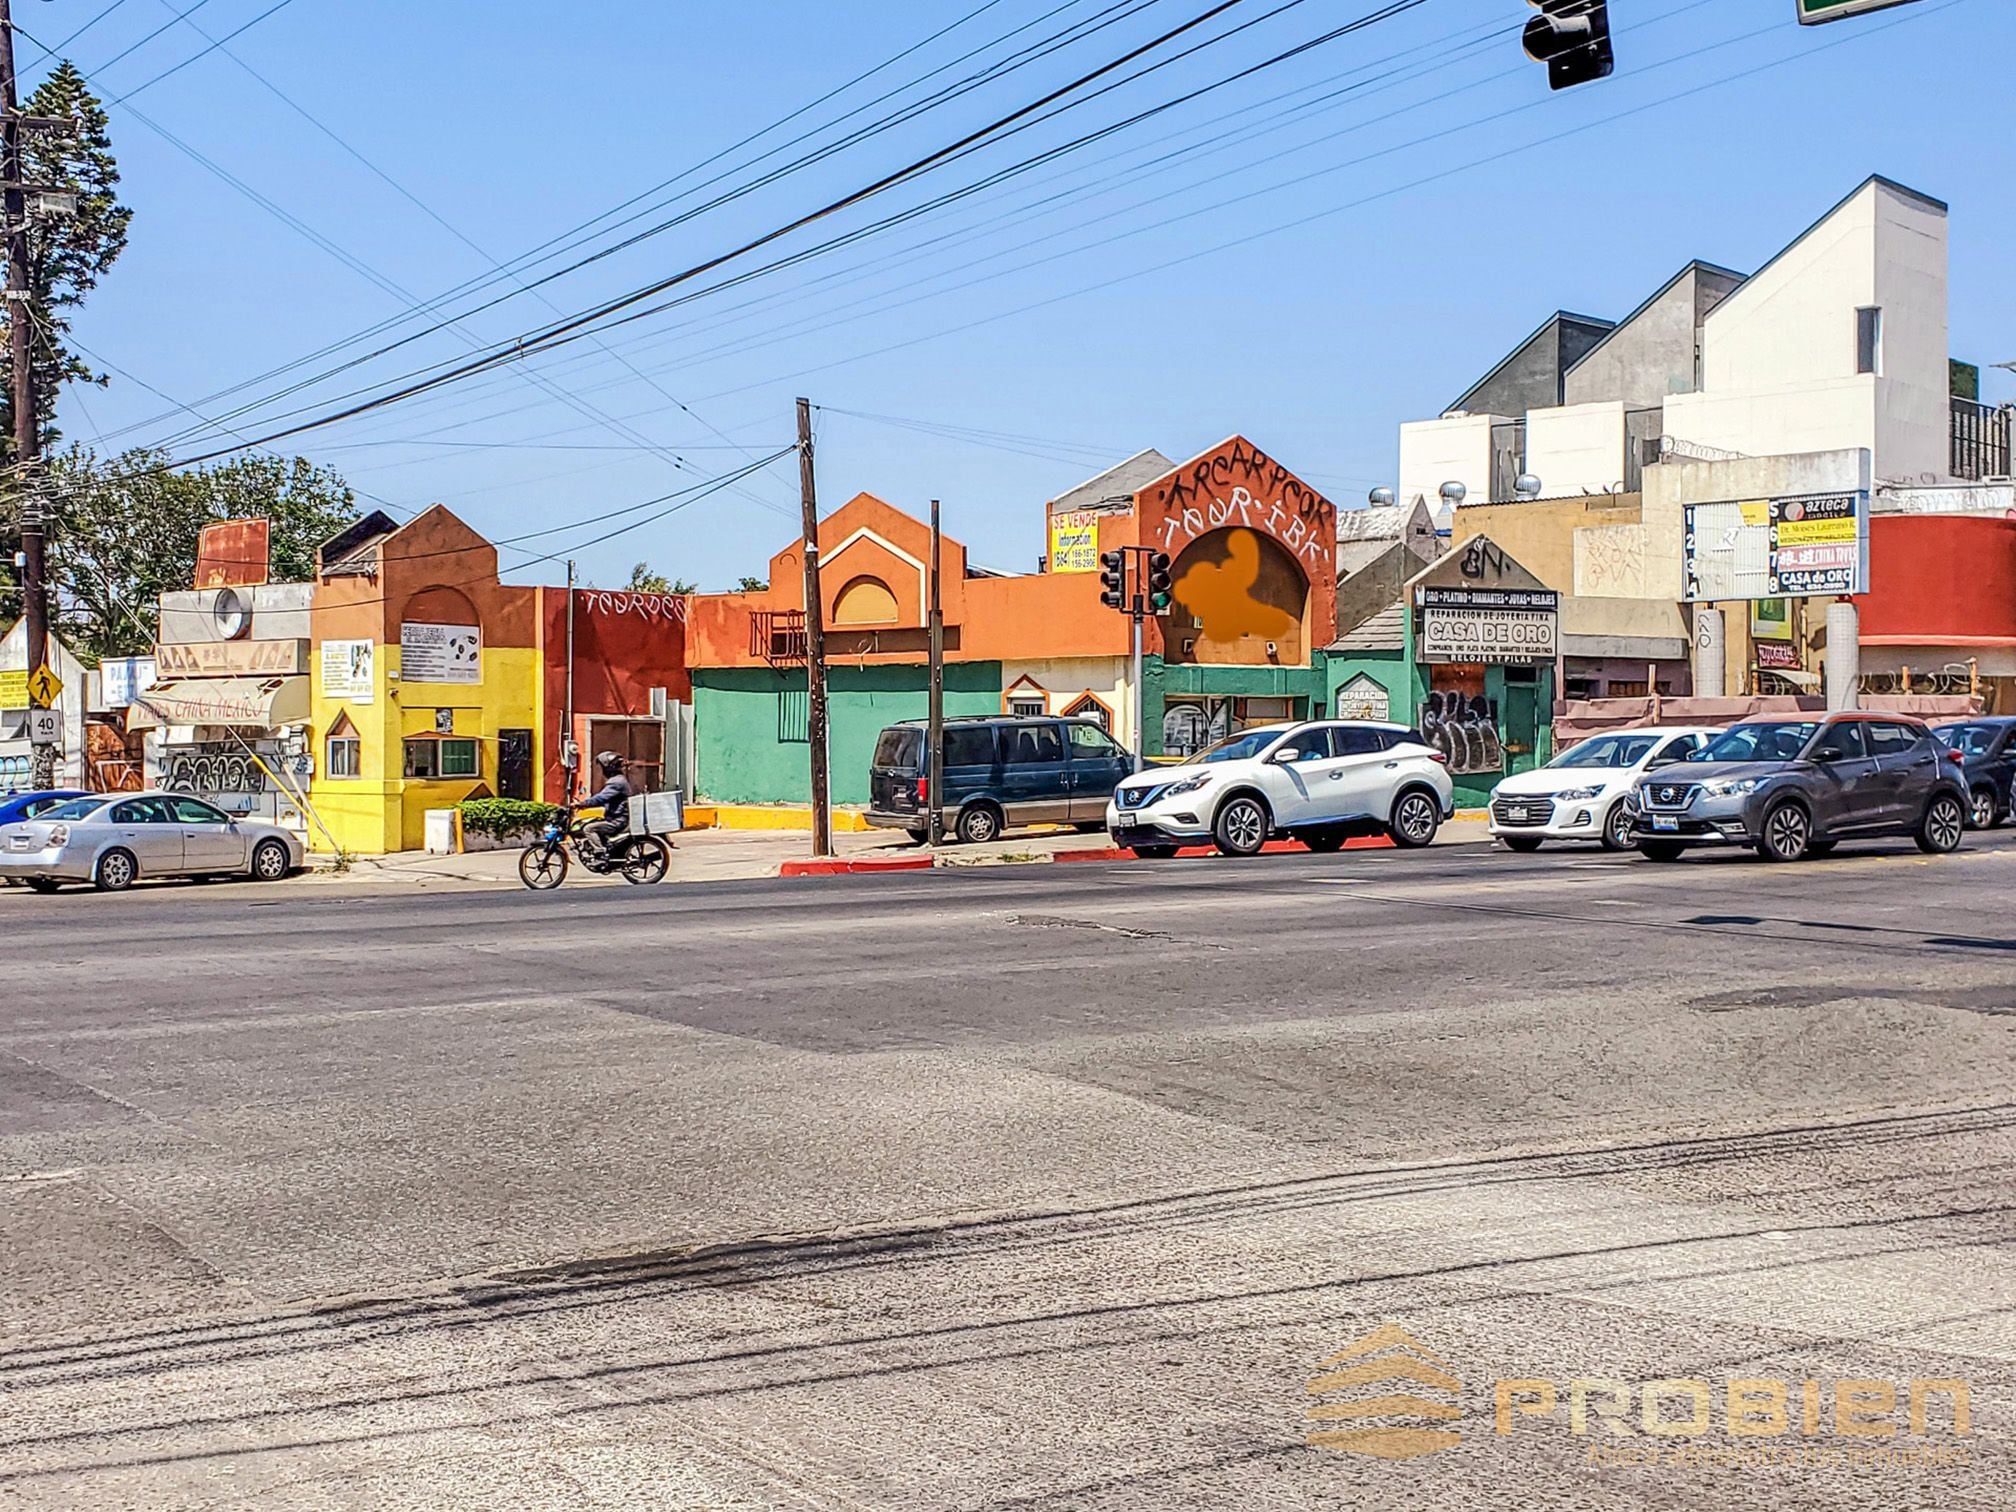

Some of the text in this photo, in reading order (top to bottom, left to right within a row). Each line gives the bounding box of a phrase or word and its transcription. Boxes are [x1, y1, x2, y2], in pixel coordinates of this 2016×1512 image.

[1769, 501, 1779, 517] 5
[1806, 498, 1849, 512] azteca
[1054, 511, 1097, 529] SE VENDE
[1686, 508, 1693, 525] 1
[1686, 533, 1695, 549] 2
[1769, 526, 1778, 543] 6
[1687, 559, 1695, 573] 3
[1769, 551, 1777, 568] 7
[1769, 576, 1778, 592] 8
[1781, 569, 1851, 585] CASA de ORO
[1425, 591, 1439, 603] ORO
[1443, 592, 1468, 603] PLATINO
[1471, 592, 1505, 604] DIAMANTES
[1531, 594, 1556, 605] RELOJES
[1430, 609, 1549, 621] REPARACION DE JOYERIA FINA
[1428, 620, 1552, 644] CASA DE ORO
[1450, 654, 1533, 664] RELOJES Y PILAS
[175, 698, 211, 718] CHINA
[214, 698, 265, 718] MEXICO
[38, 717, 54, 730] 40
